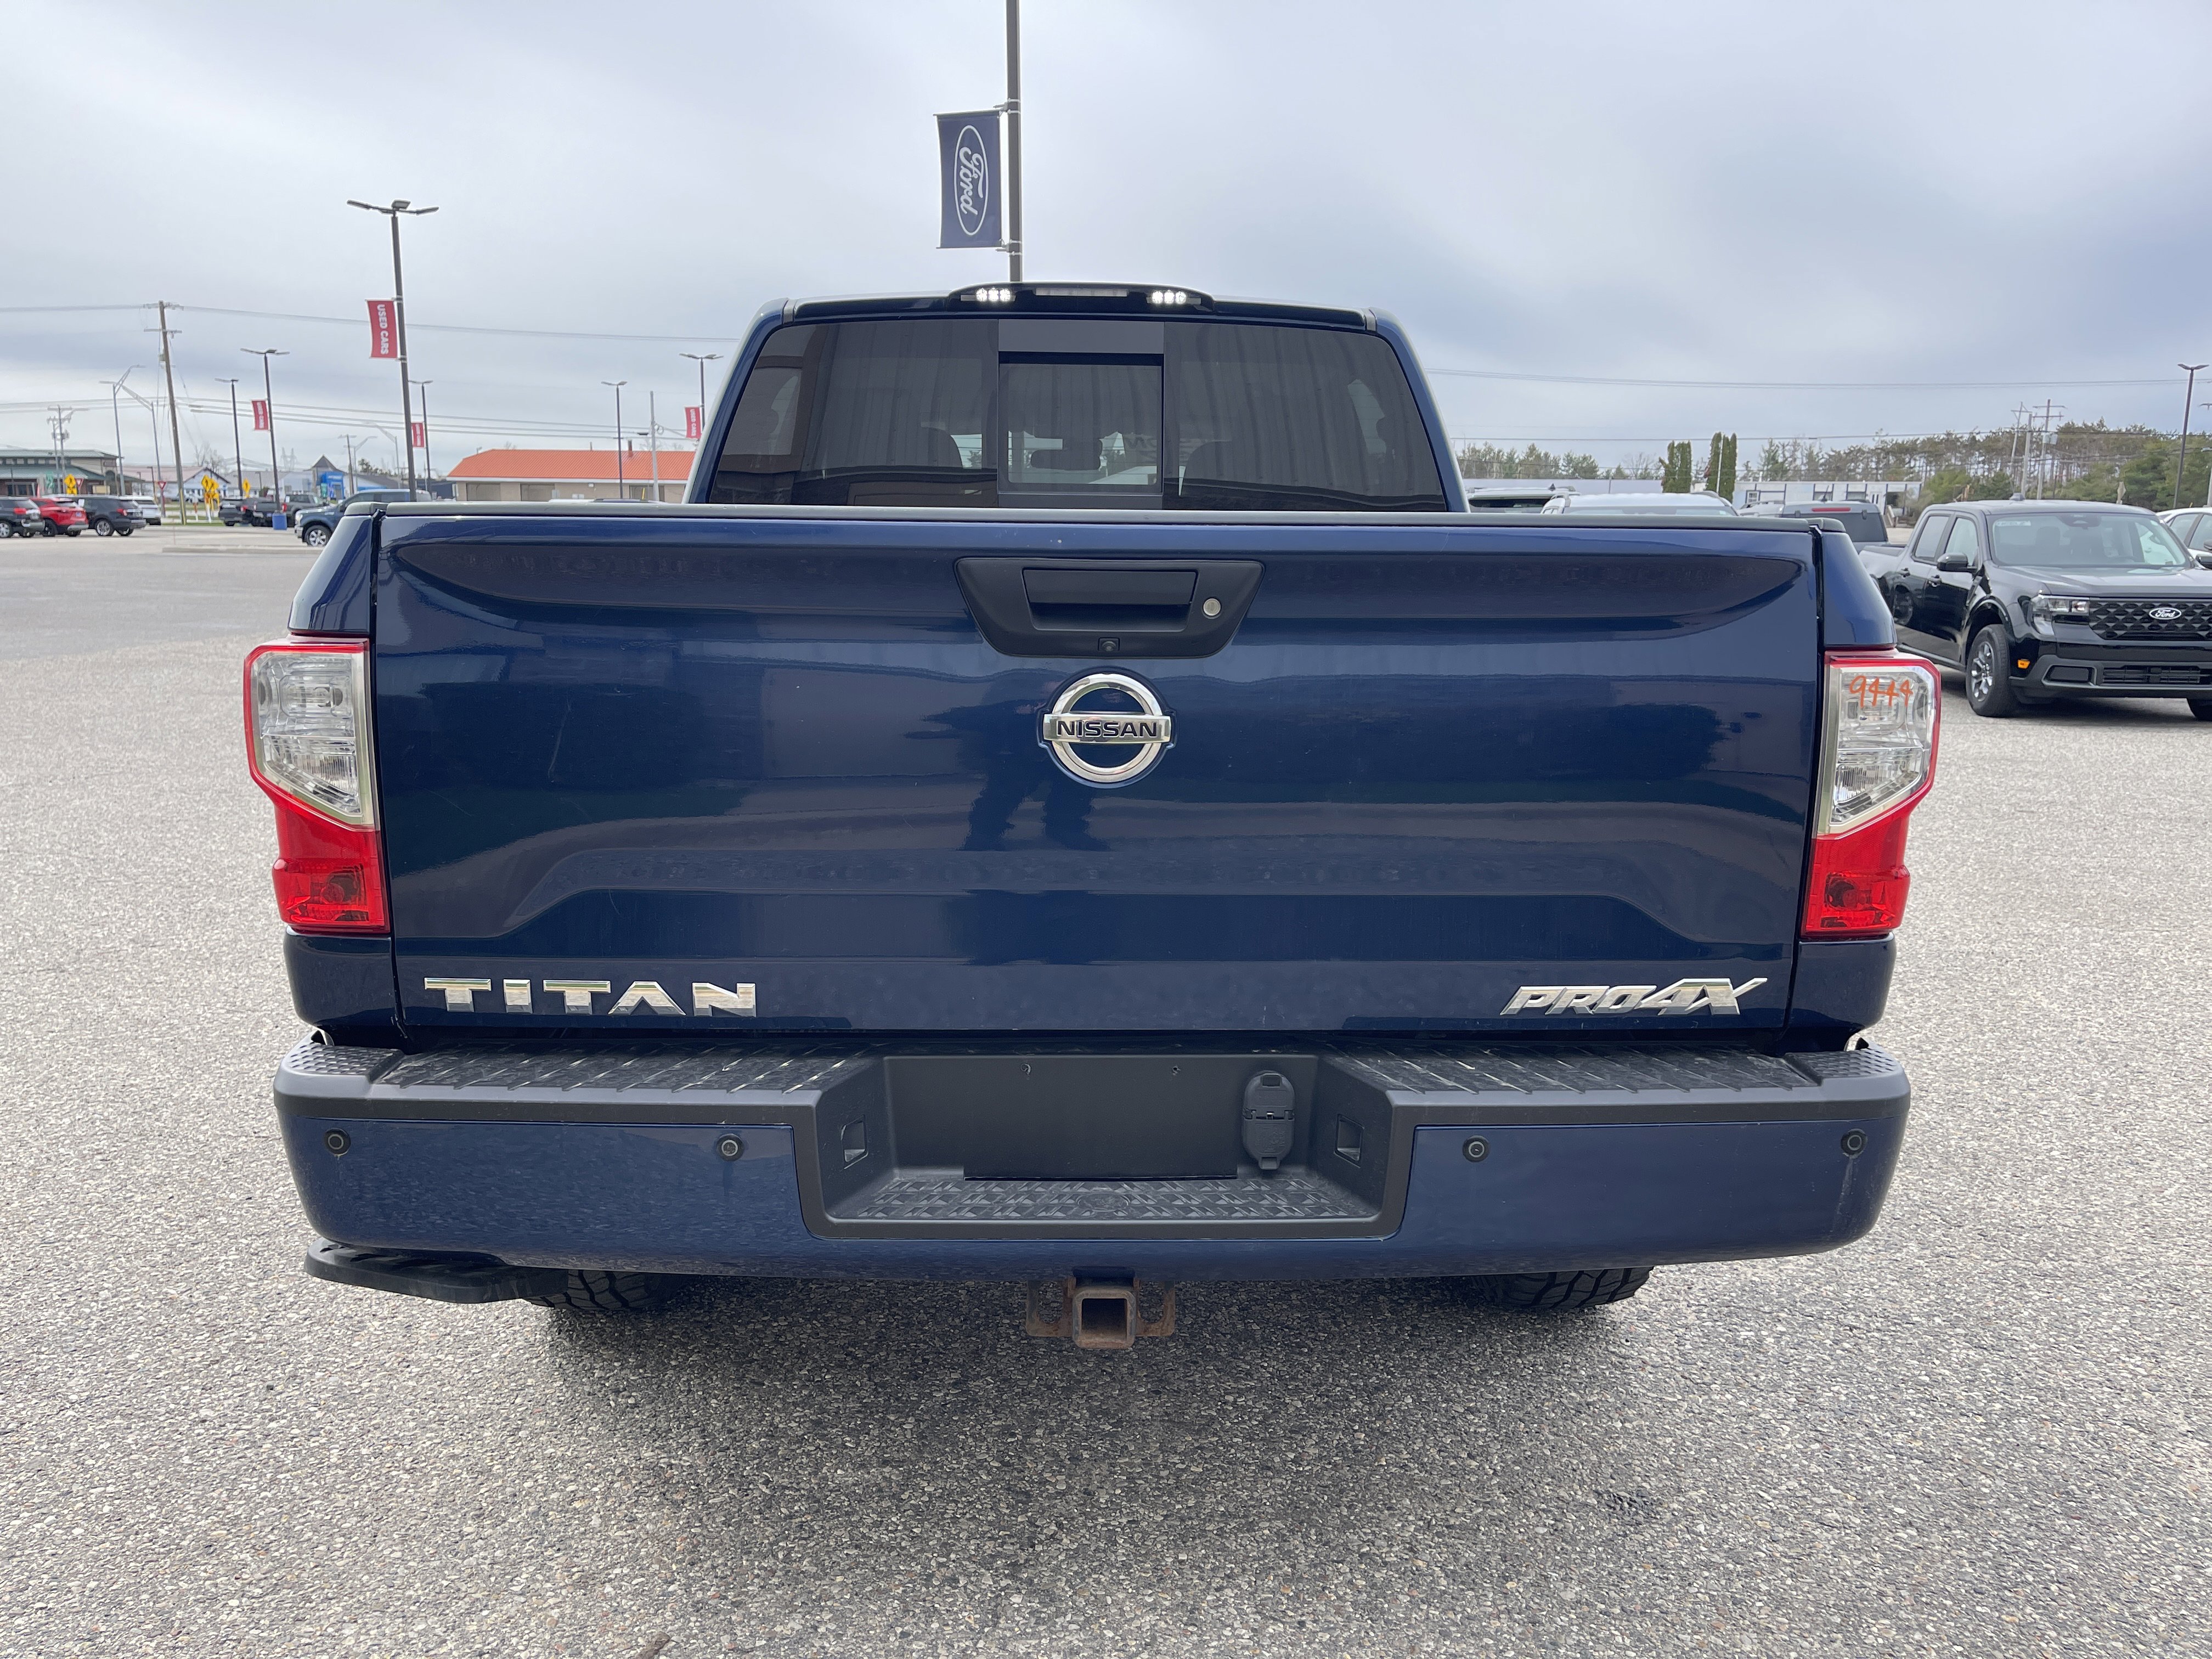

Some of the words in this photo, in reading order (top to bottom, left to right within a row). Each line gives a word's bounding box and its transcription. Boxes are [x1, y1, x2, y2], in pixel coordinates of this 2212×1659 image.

[959, 146, 984, 216] Ford
[377, 303, 388, 329] USED
[380, 330, 389, 355] CARS
[2154, 608, 2176, 618] Ford
[1056, 720, 1158, 738] NISSAN
[424, 977, 757, 1018] TITAN
